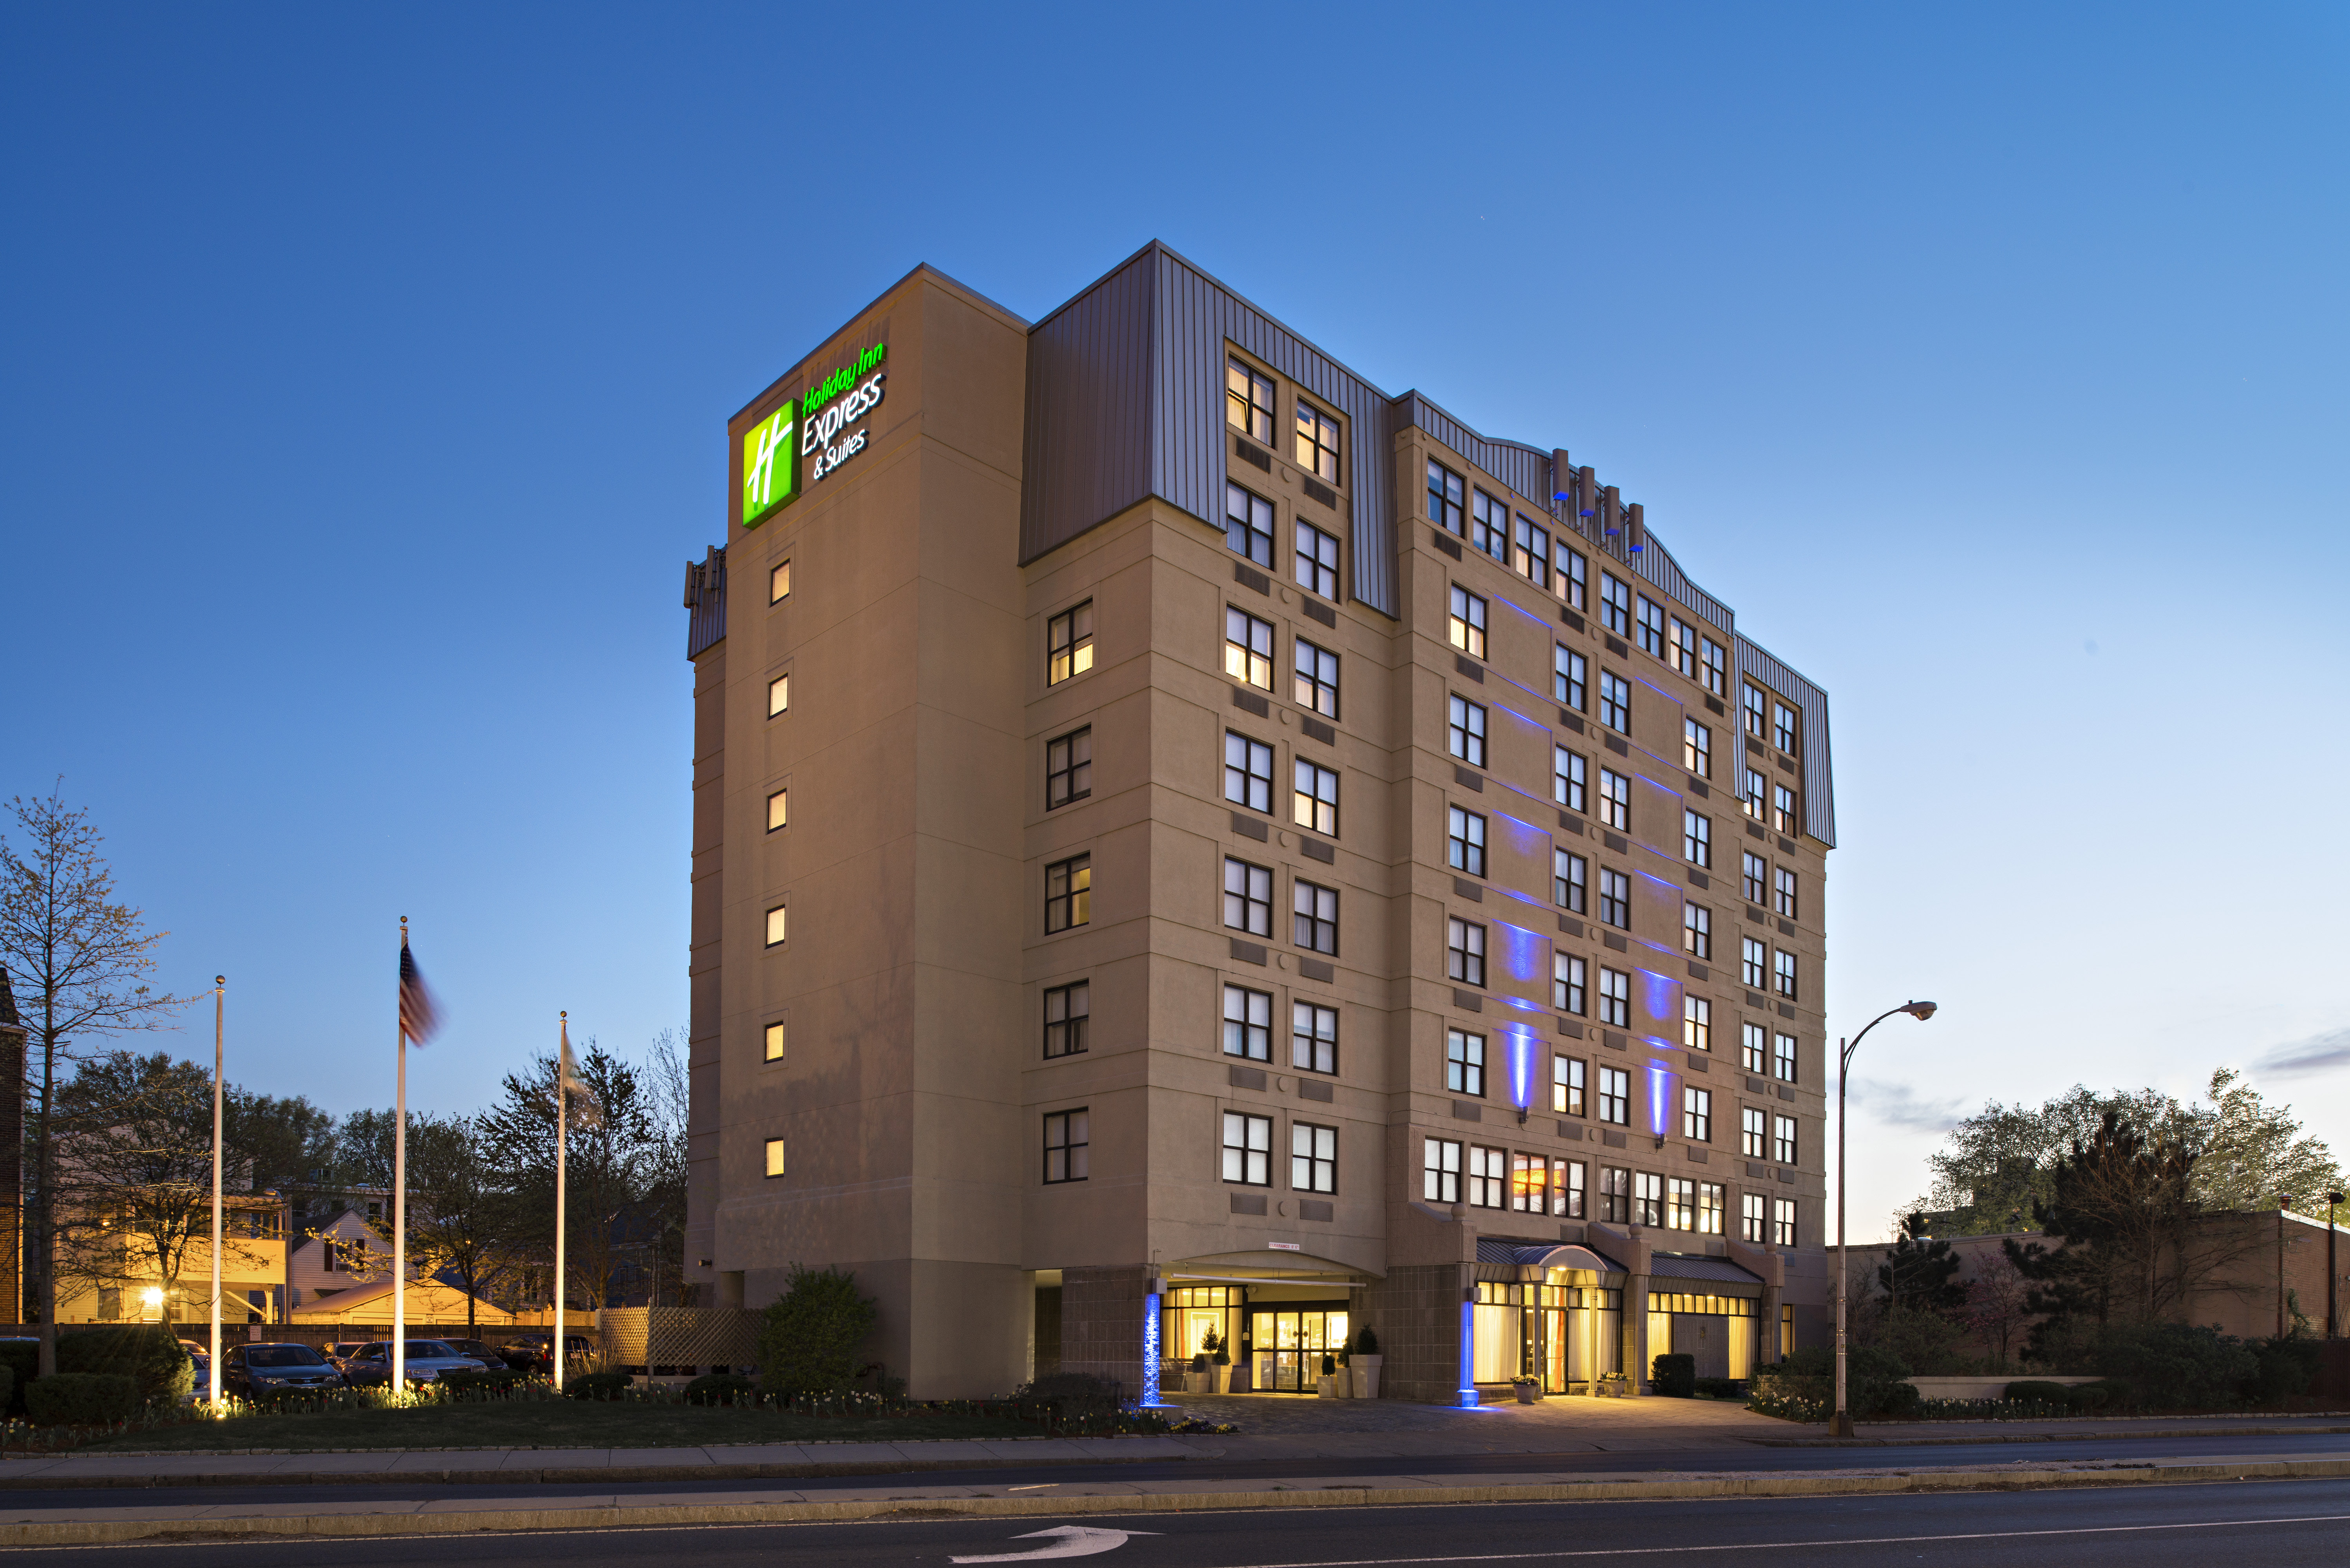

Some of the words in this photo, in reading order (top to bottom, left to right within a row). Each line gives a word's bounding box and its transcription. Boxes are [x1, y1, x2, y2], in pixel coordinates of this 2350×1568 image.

[802, 373, 882, 456] Express
[803, 362, 857, 417] Holiday
[858, 343, 883, 376] Inn
[813, 455, 823, 480] &
[825, 429, 865, 471] Suites
